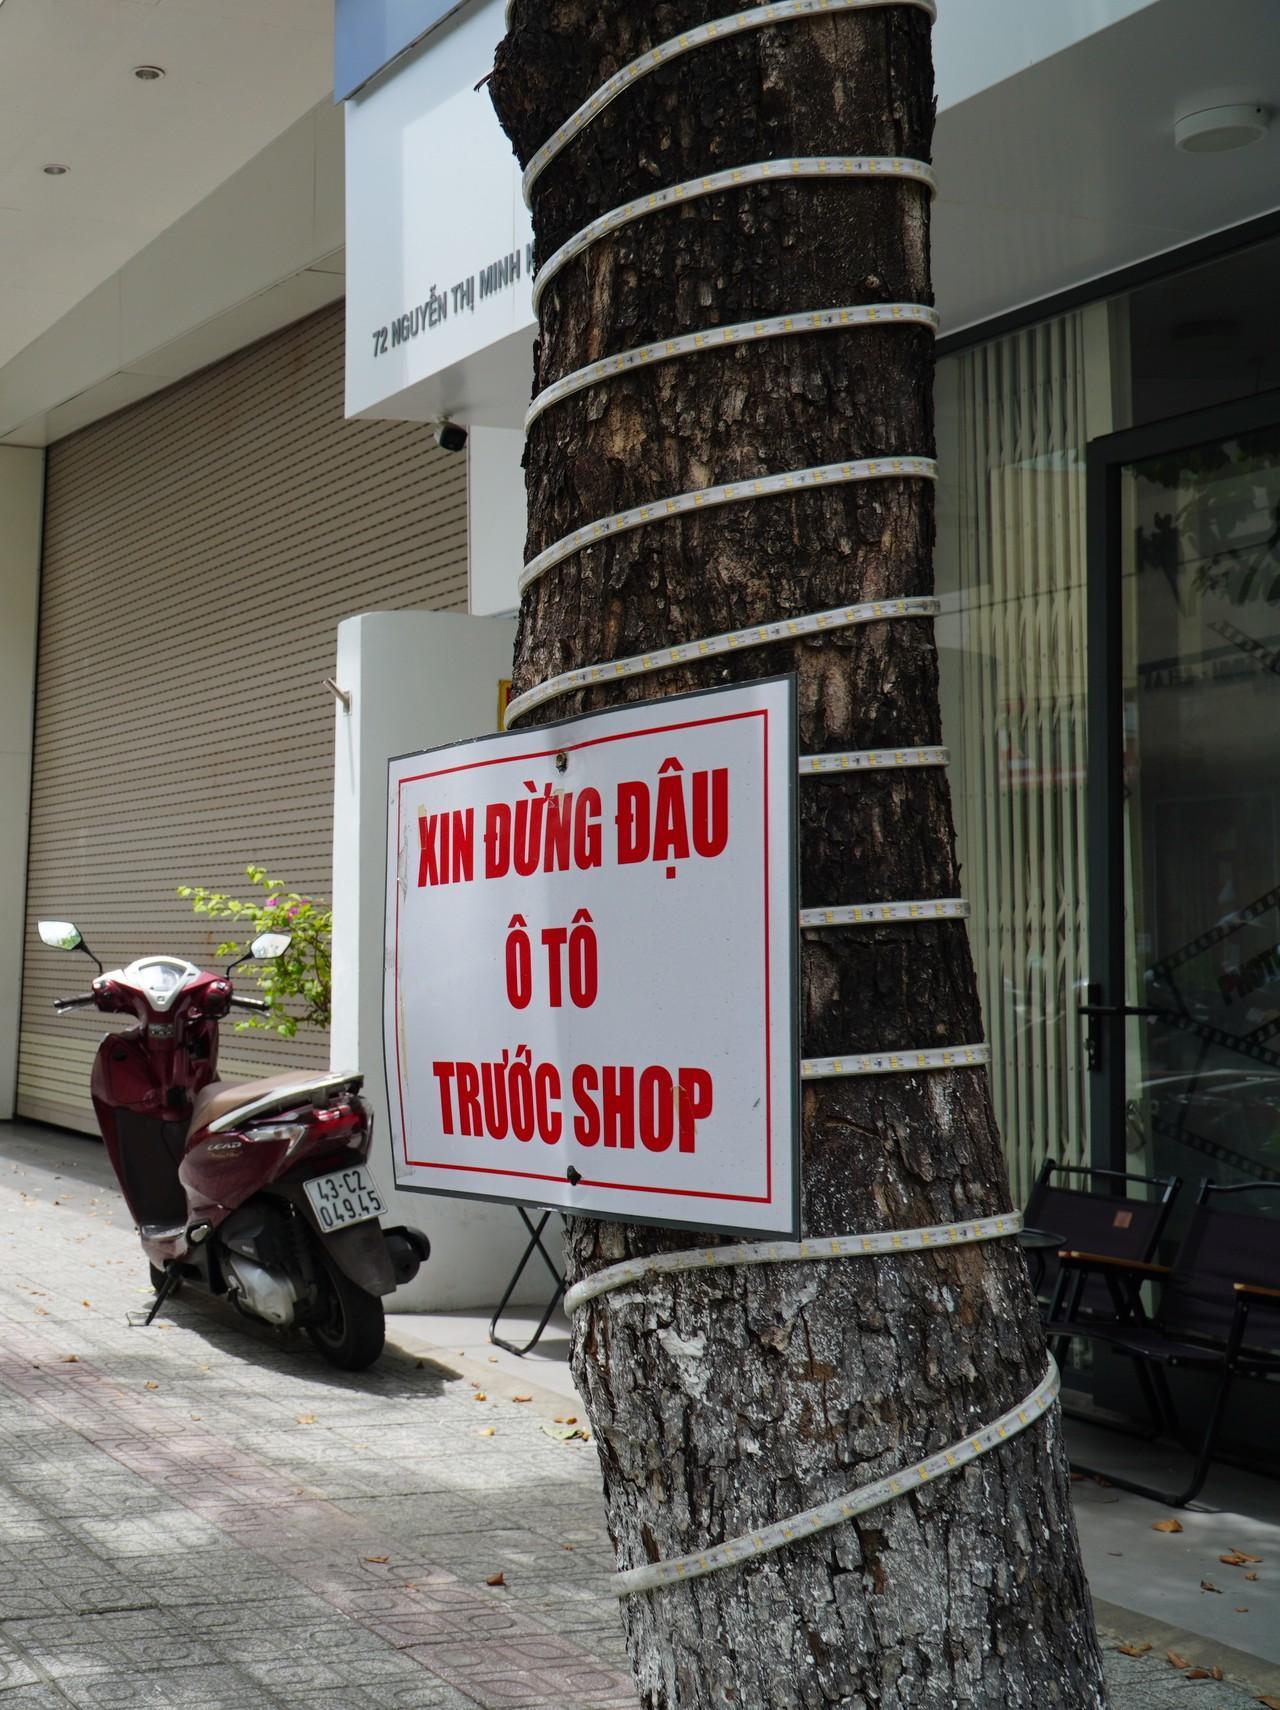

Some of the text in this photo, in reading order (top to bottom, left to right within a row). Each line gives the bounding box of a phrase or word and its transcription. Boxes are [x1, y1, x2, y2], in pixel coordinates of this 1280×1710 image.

[372, 326, 388, 358] 72
[391, 284, 448, 348] NGUYỄN
[451, 275, 475, 313] THỊ
[479, 248, 521, 300] MINH
[417, 757, 729, 888] XIN ĐỪNG ĐẬU
[505, 908, 598, 1010] Ô TÔ
[432, 1045, 713, 1154] TRƯỚC SHOP
[320, 1190, 382, 1227] 049.45
